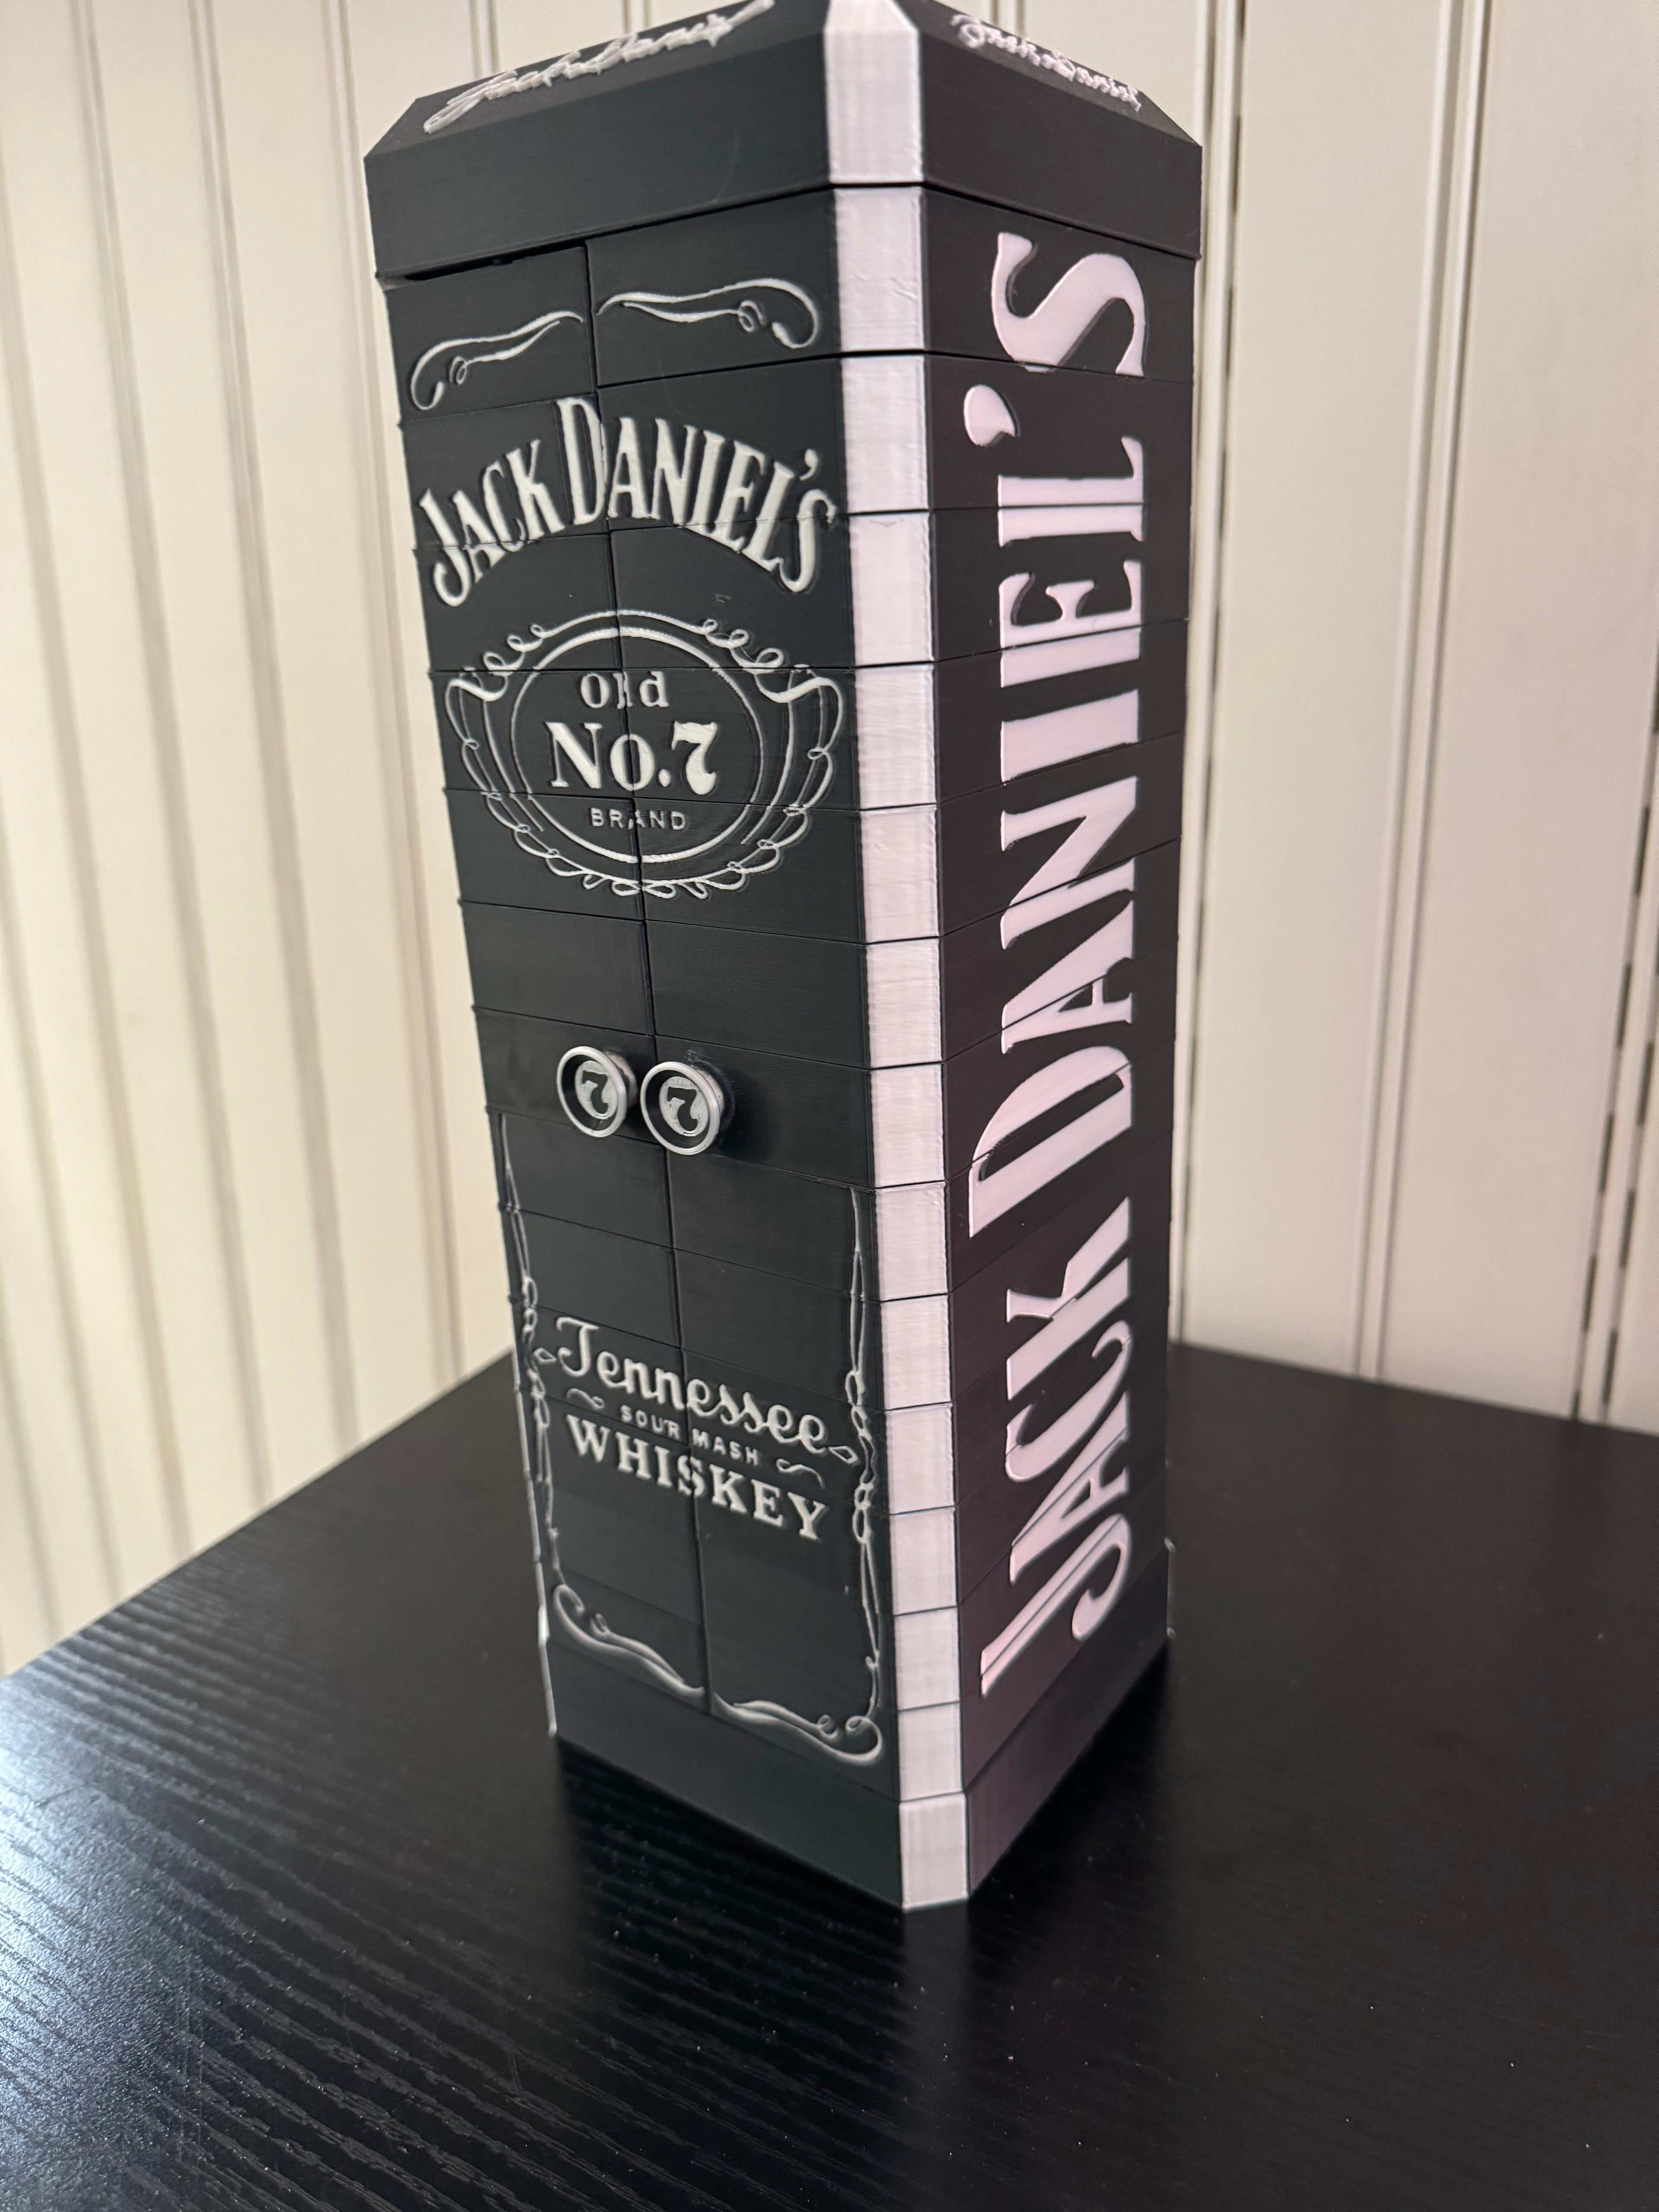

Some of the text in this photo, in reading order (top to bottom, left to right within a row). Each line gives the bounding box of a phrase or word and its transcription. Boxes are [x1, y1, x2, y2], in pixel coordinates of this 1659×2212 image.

[419, 397, 837, 606] JACK DANIEL'S
[581, 672, 669, 709] Old
[963, 232, 1146, 1237] DANIEL'S
[591, 807, 686, 830] BRAND
[583, 1070, 608, 1114] 7
[667, 1087, 698, 1131] 7
[556, 1316, 828, 1453] Tennessee
[567, 1414, 826, 1541] WHISKEY
[621, 1404, 759, 1465] SOUR MASH
[980, 1197, 1133, 1697] JACK
